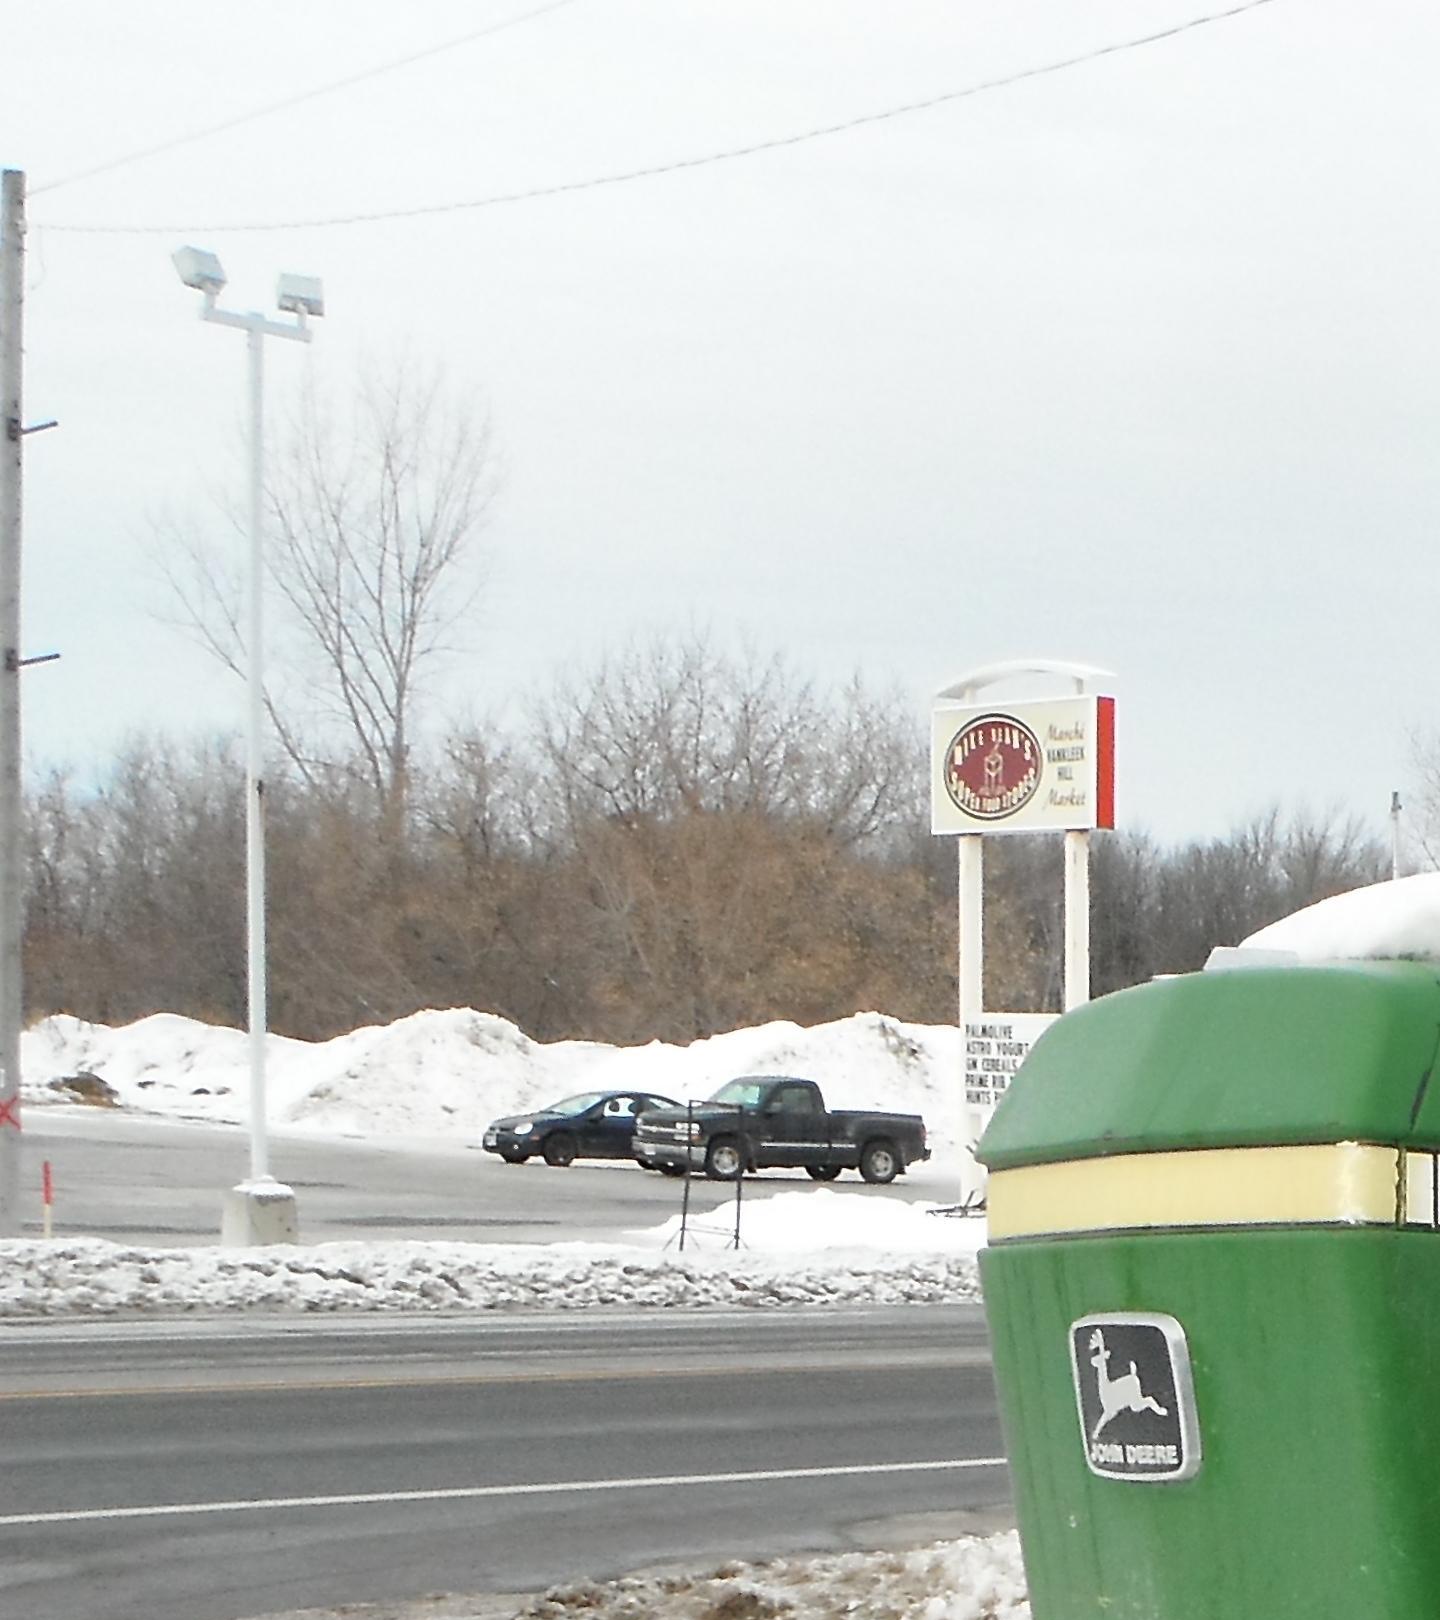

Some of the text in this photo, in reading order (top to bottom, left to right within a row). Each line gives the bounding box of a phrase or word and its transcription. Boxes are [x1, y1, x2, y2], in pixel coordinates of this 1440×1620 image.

[965, 1024, 1013, 1039] PALMOLIVE
[966, 1041, 991, 1055] ASTRO
[982, 1058, 1018, 1072] CEREALS
[965, 1073, 988, 1087] PRIME
[992, 1074, 1005, 1088] RIB
[966, 1090, 990, 1104] HUNTS
[1091, 1443, 1179, 1464] JOHN DEERE
